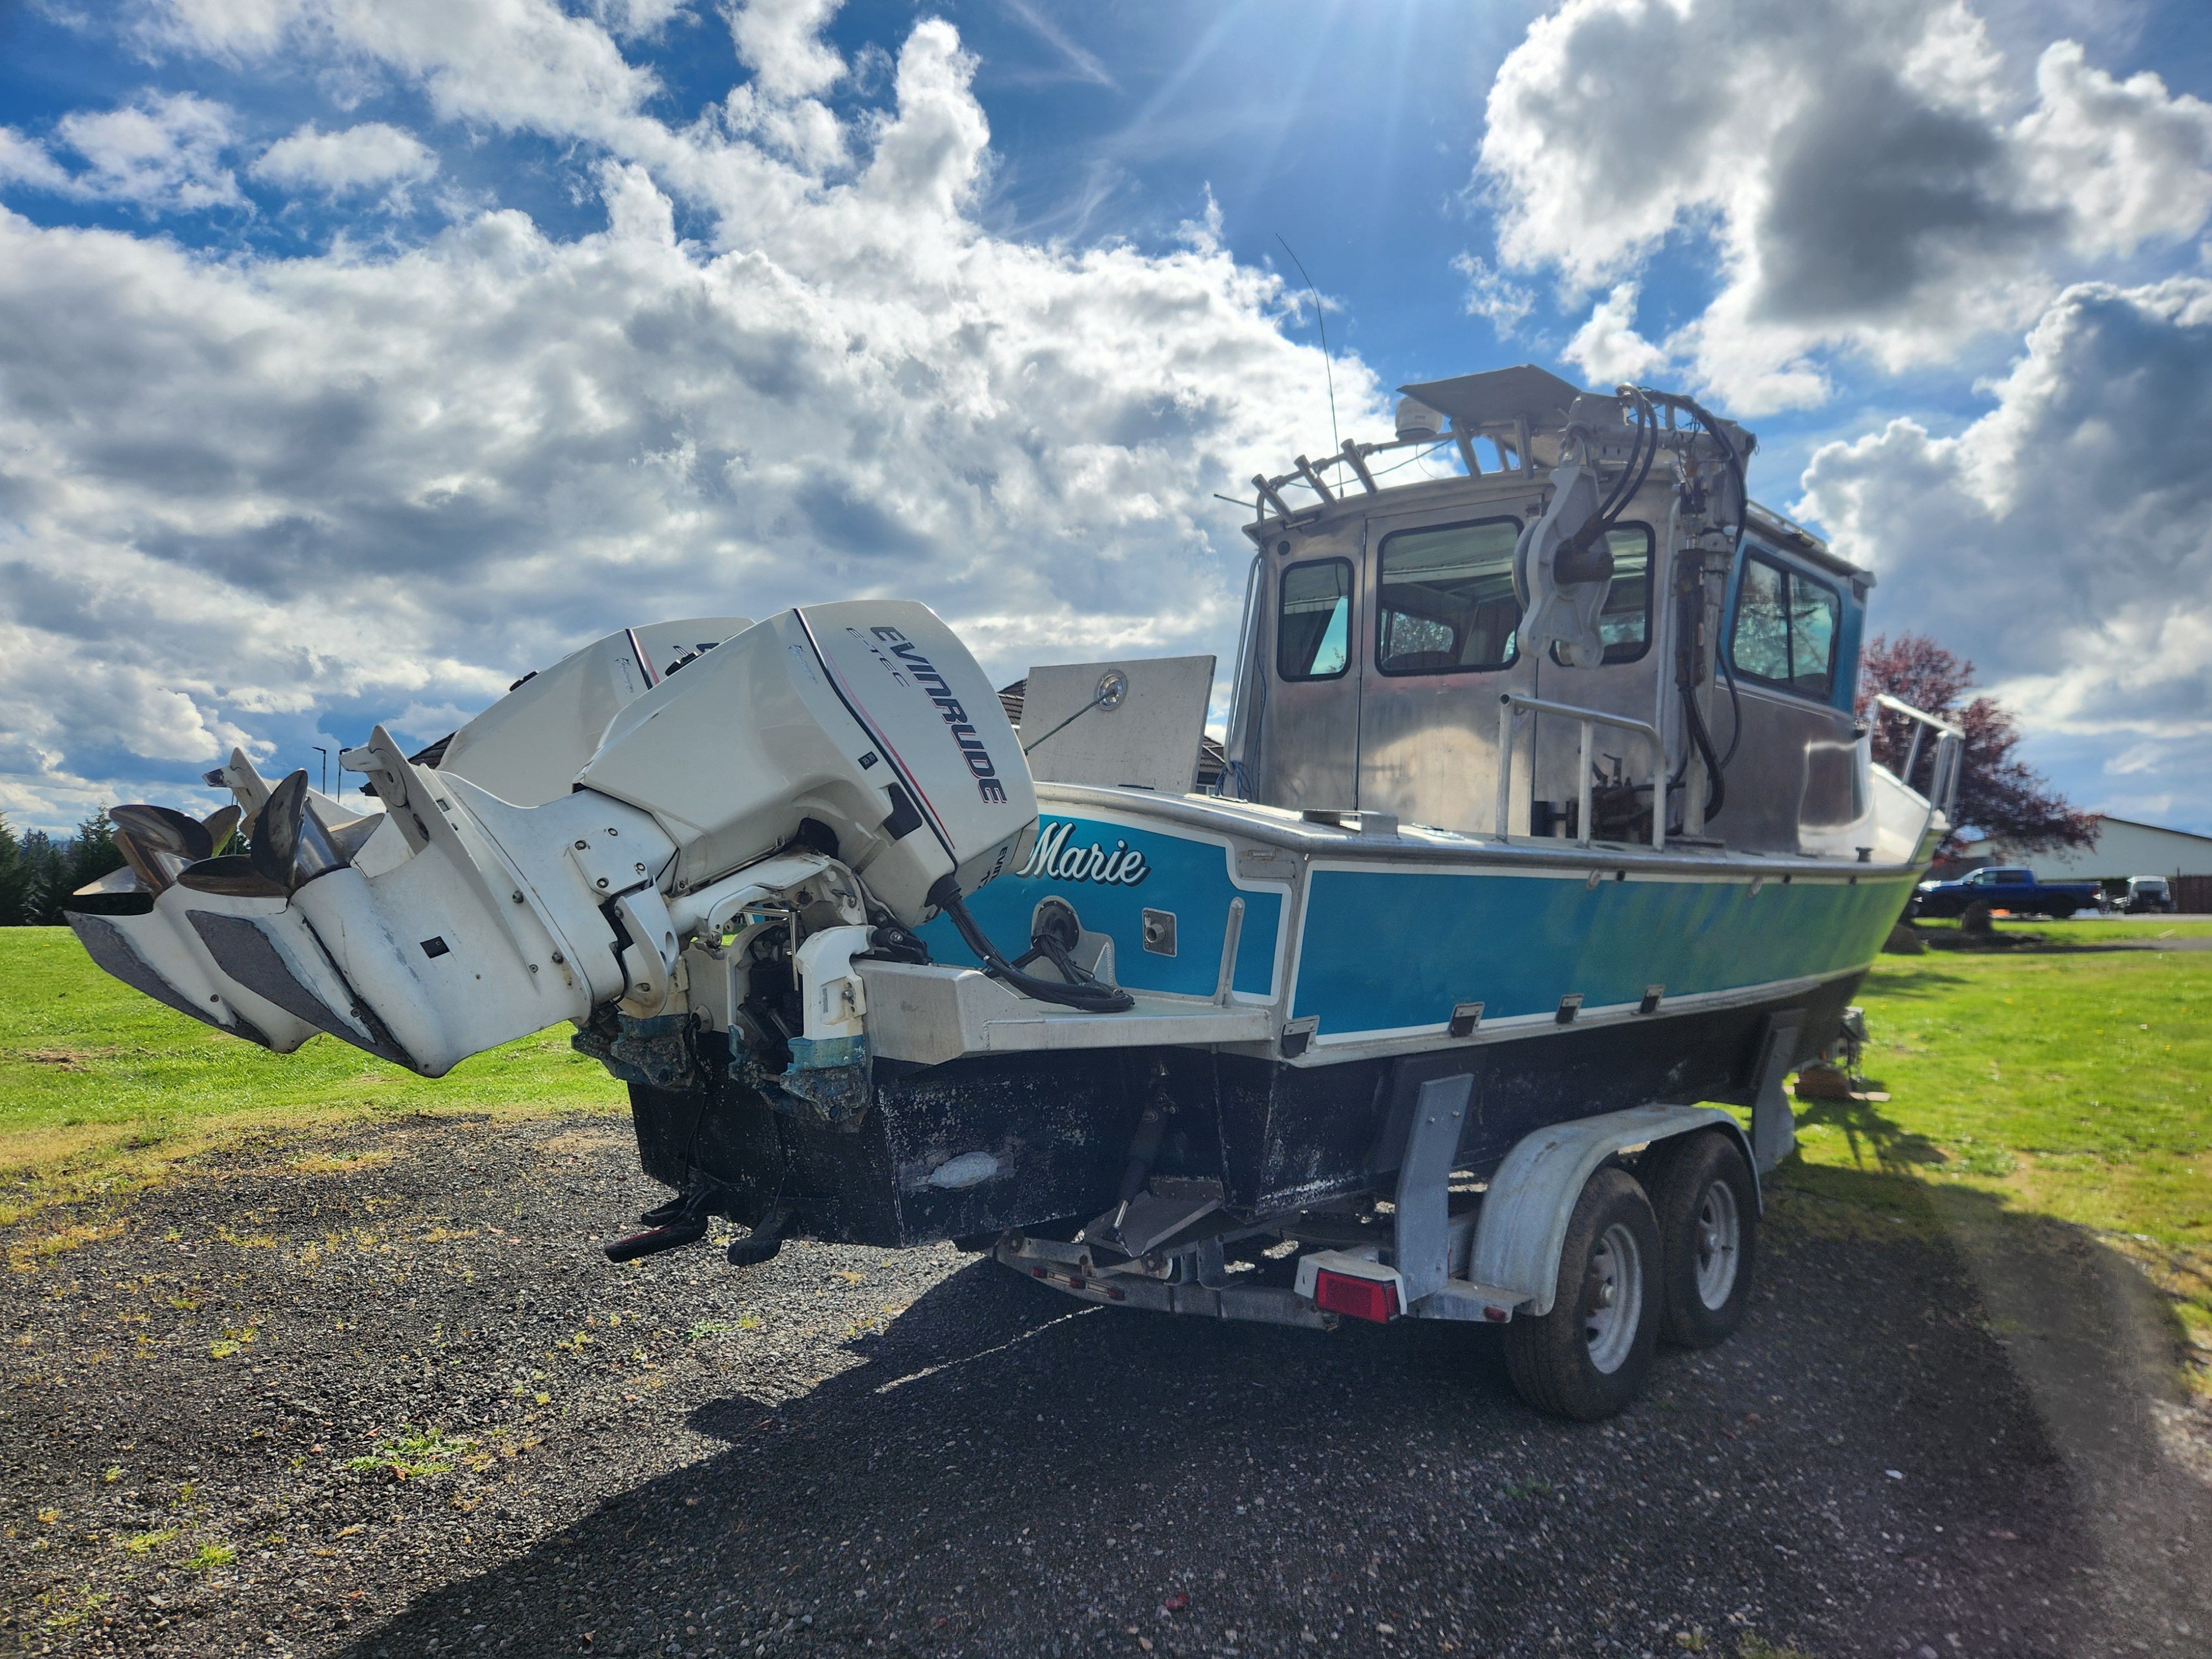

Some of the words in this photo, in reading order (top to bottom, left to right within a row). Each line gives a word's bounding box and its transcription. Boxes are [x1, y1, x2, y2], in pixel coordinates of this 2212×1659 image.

[846, 627, 911, 687] E-TEC
[870, 626, 1008, 804] EVINRUDE
[1016, 821, 1151, 886] Marie
